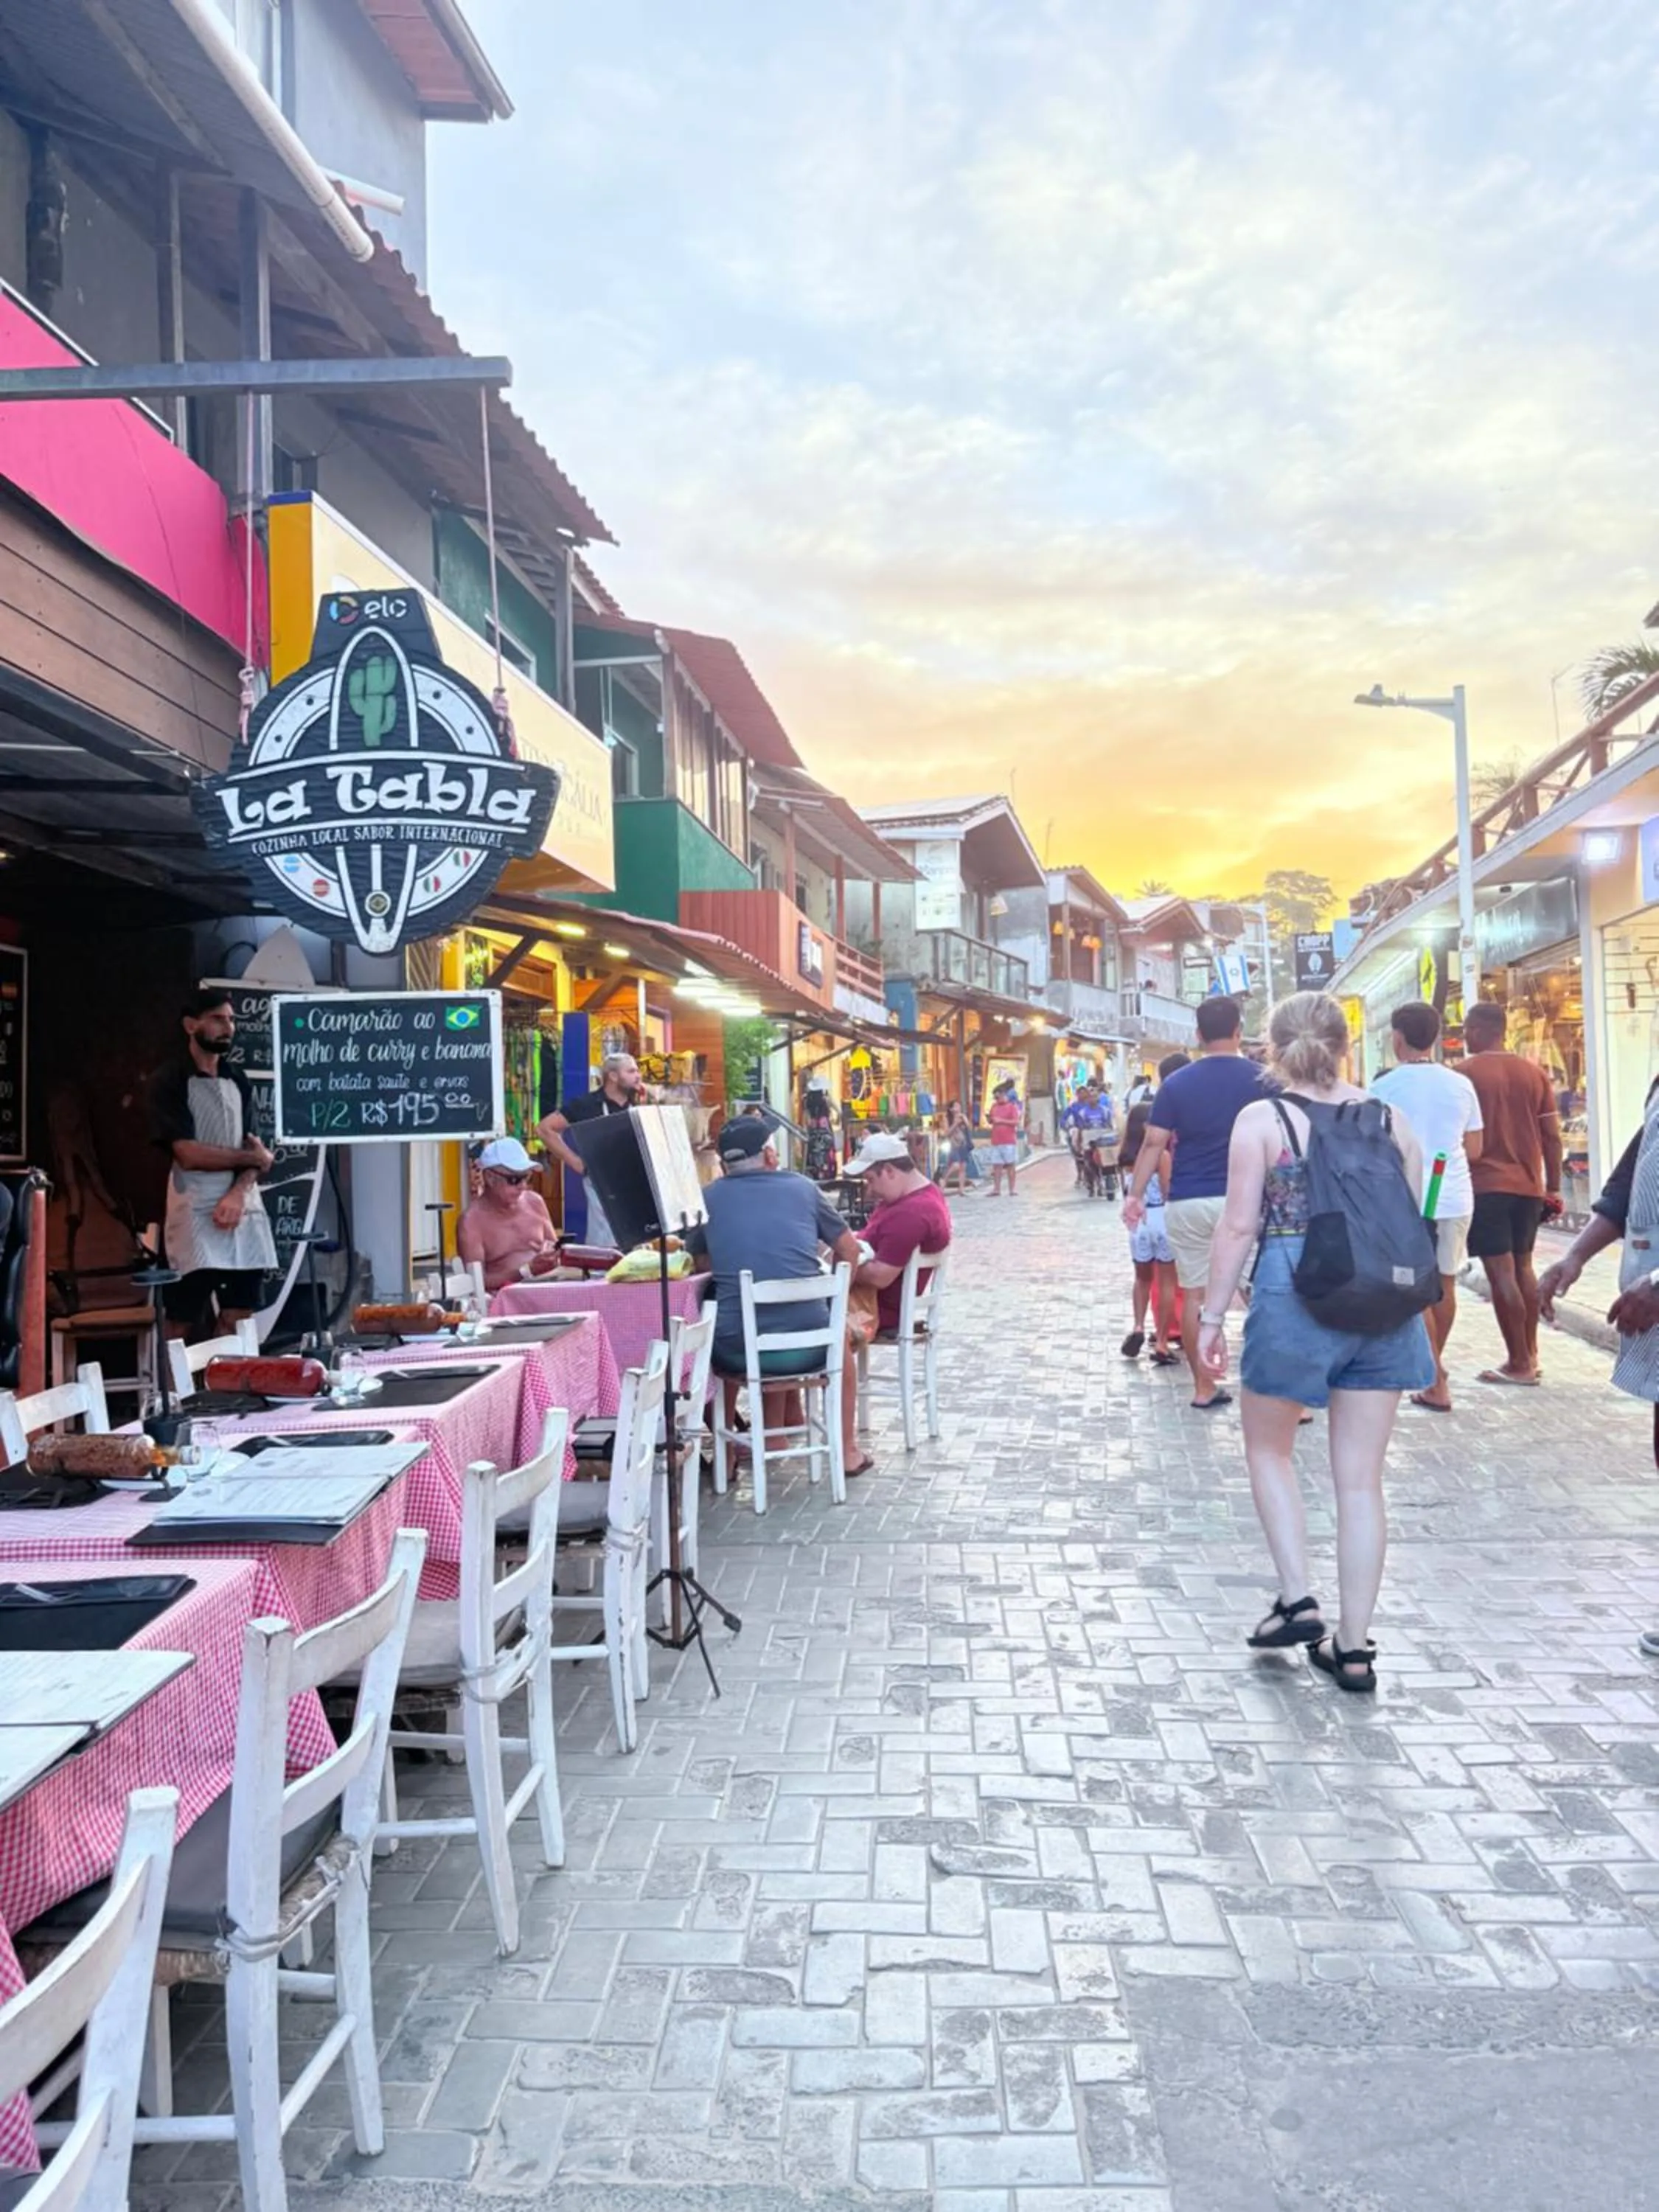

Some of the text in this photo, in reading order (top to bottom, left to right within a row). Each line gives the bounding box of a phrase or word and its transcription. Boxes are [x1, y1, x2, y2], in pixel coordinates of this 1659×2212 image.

[215, 779, 312, 835] La
[326, 762, 536, 824] Tabla
[251, 825, 504, 855] COZINHA LOCAL SABOR INTERNACIONAL
[307, 1007, 436, 1034] Camarão ao
[283, 1038, 334, 1068] molho
[339, 1037, 361, 1062] de
[368, 1042, 416, 1070] curry
[421, 1045, 431, 1060] e
[296, 1077, 322, 1092] com
[329, 1071, 372, 1091] batata
